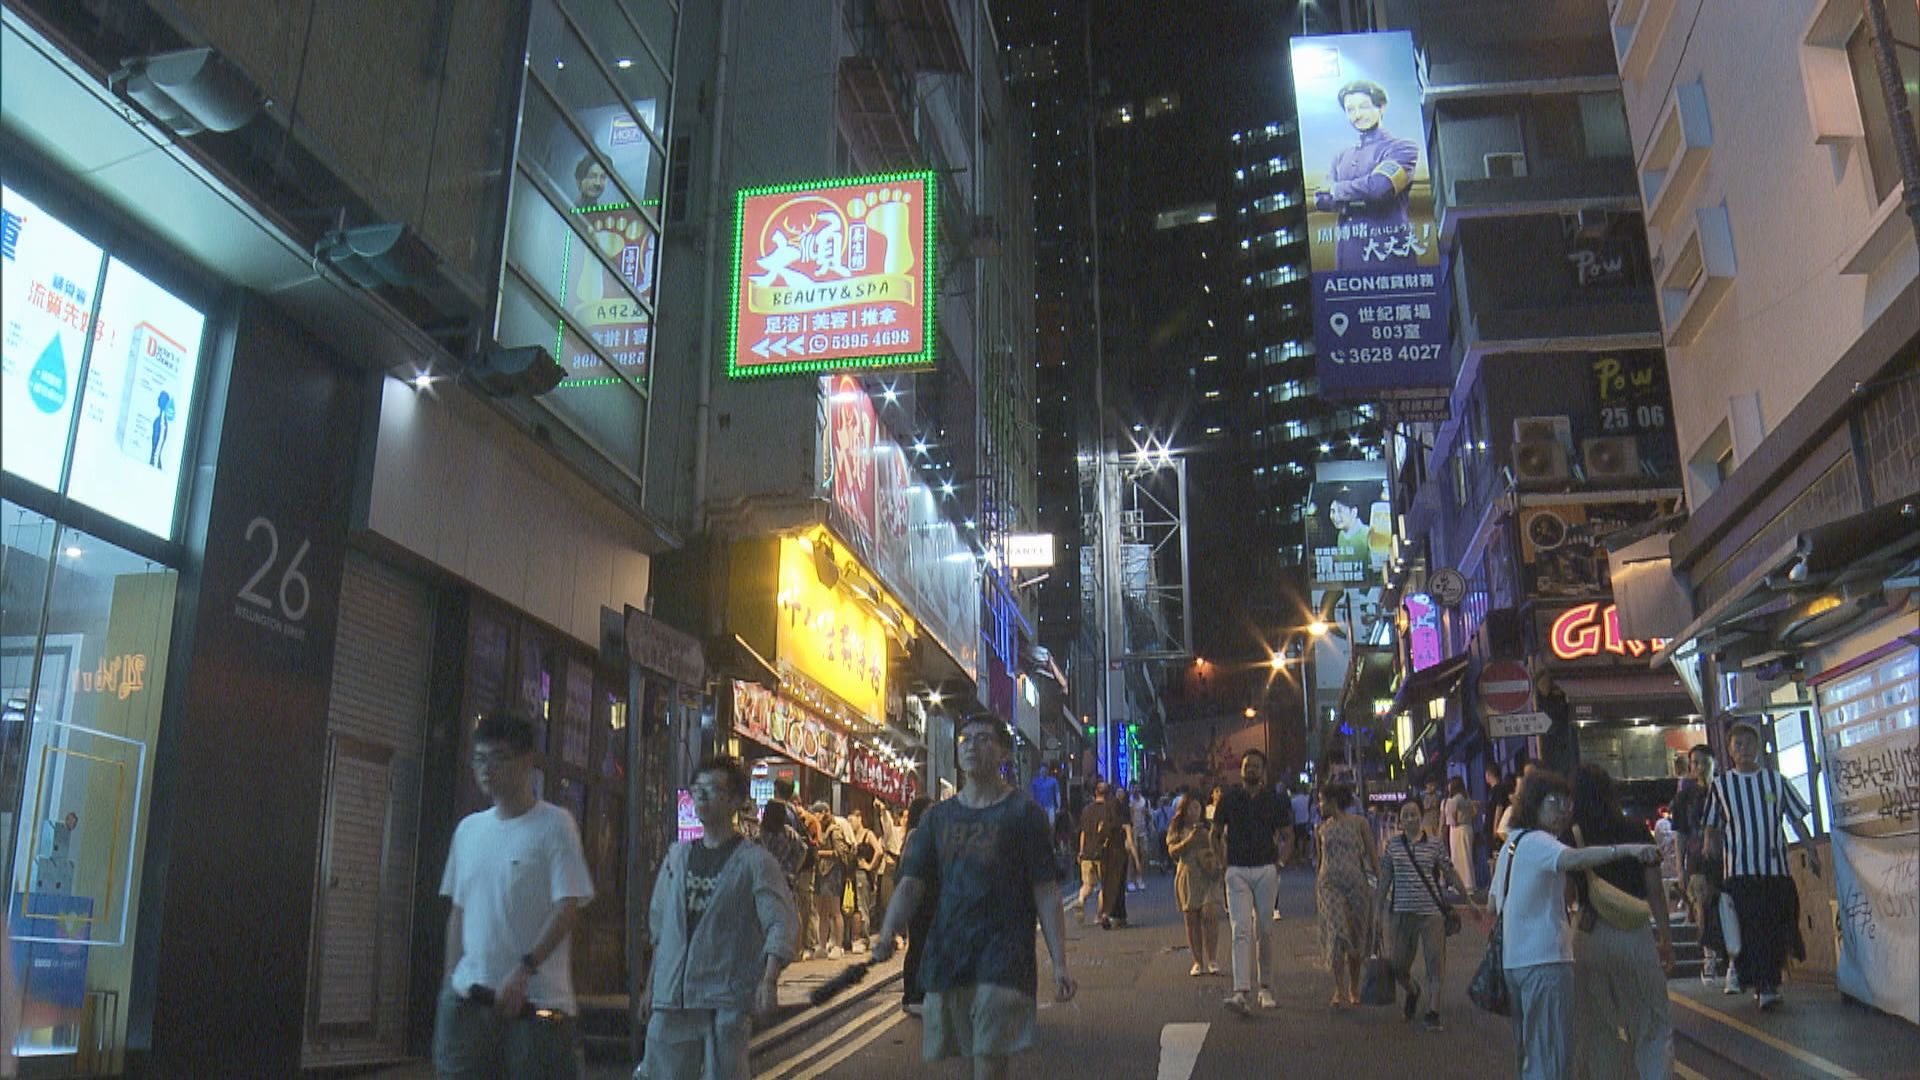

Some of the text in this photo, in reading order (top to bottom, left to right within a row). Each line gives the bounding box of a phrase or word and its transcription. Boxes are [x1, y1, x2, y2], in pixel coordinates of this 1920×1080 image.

[1358, 304, 1431, 323] 世紀廣場
[872, 329, 910, 347] 4698
[1371, 324, 1421, 340] 803室
[1350, 344, 1441, 363] 3628 4027
[237, 517, 311, 621] 26
